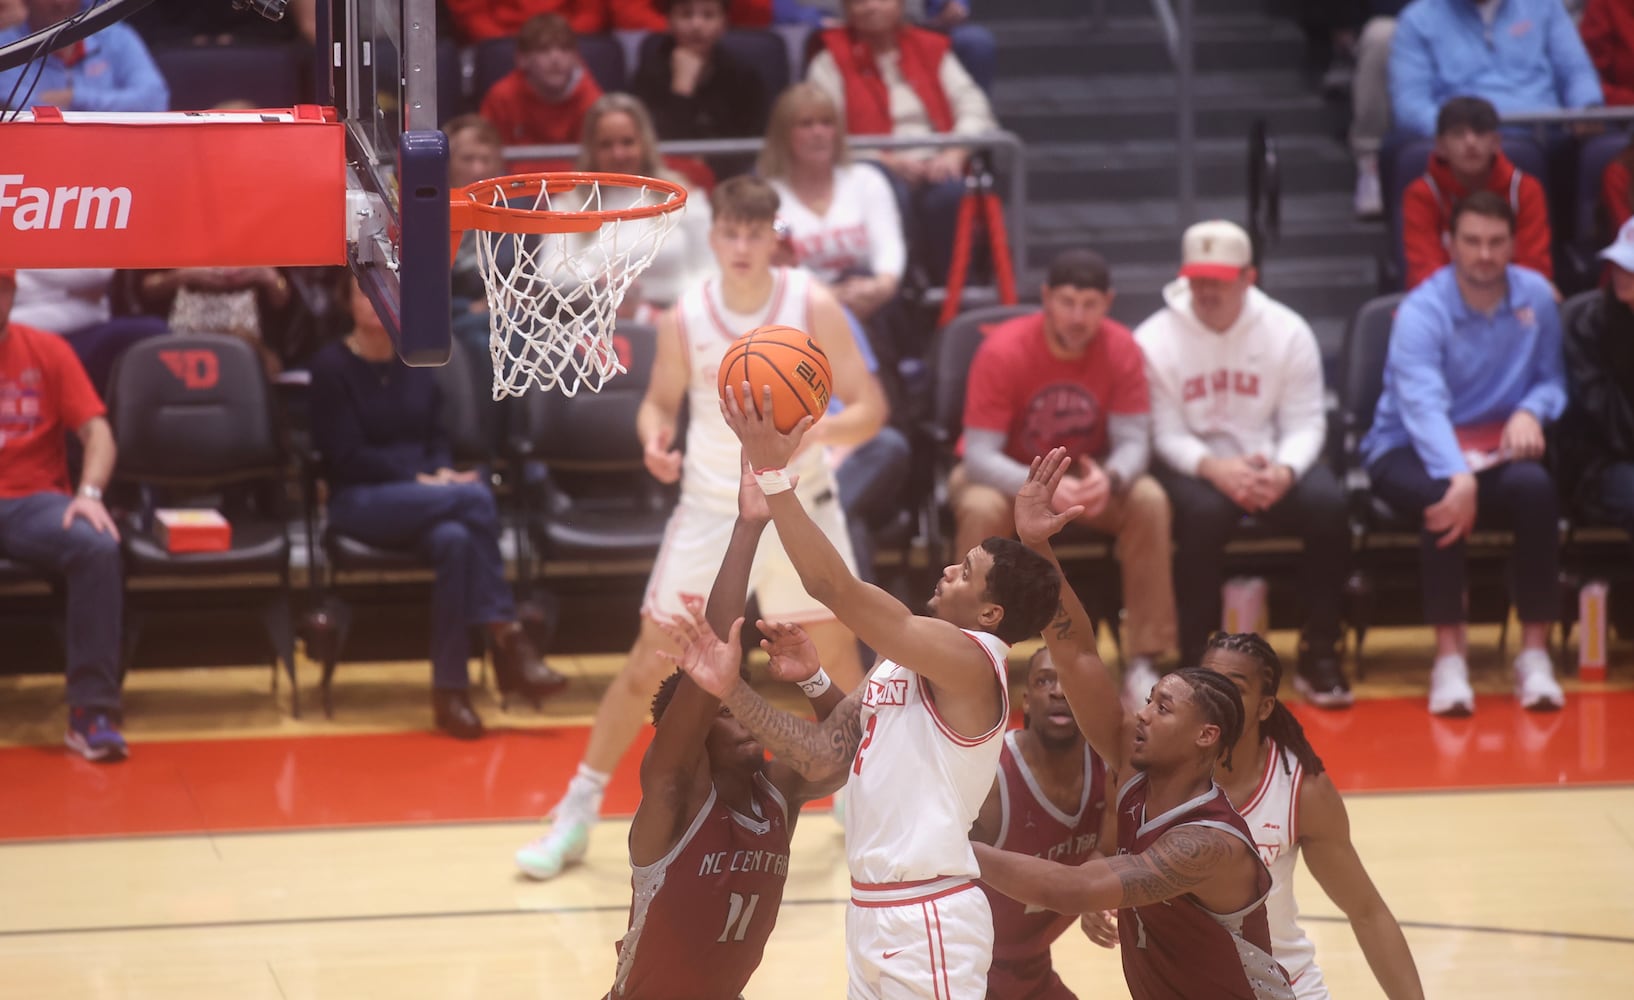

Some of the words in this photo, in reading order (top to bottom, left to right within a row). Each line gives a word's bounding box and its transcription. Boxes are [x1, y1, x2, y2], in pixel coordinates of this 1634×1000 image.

[0, 174, 132, 231] Farm
[796, 360, 830, 409] ELITE
[853, 713, 877, 776] 2
[698, 851, 727, 876] NC
[716, 892, 760, 942] 11
